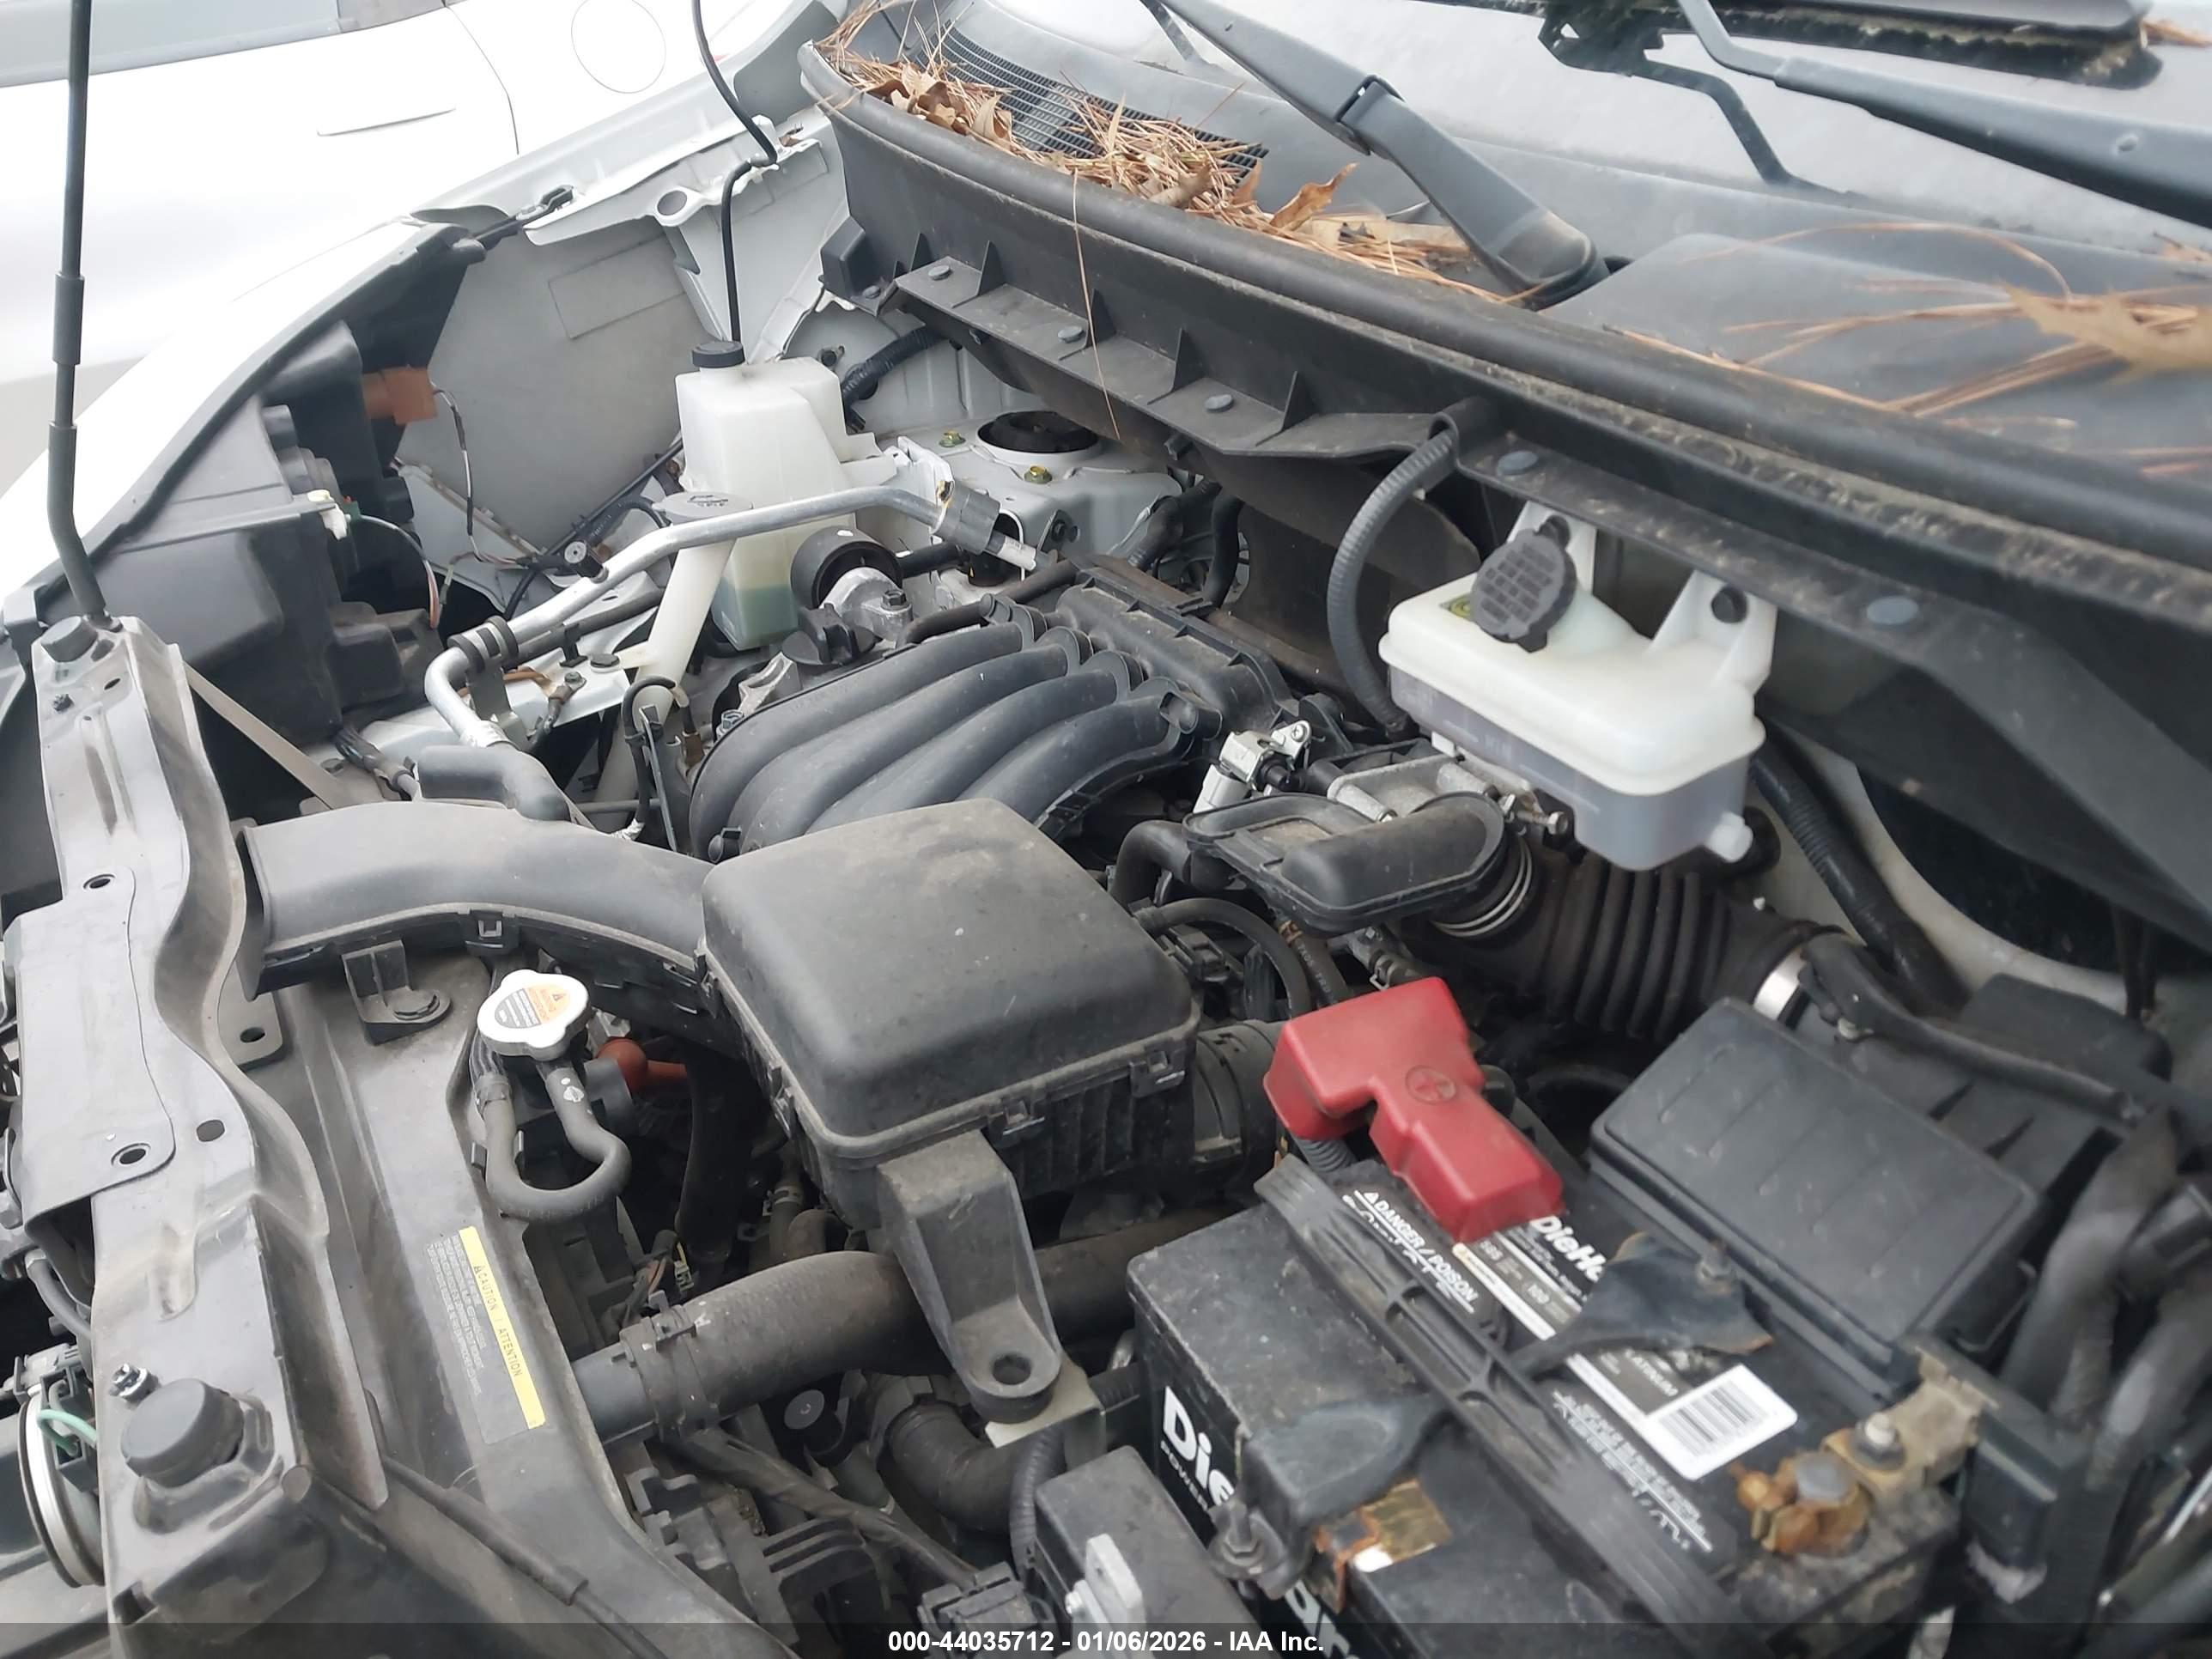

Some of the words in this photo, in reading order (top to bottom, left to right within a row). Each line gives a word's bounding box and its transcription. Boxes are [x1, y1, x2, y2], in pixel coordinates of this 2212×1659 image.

[1374, 1200, 1425, 1248] DANGER
[1427, 1255, 1479, 1302] POISON
[477, 1272, 499, 1312] CAUTION
[497, 1328, 523, 1377] ATTENTION
